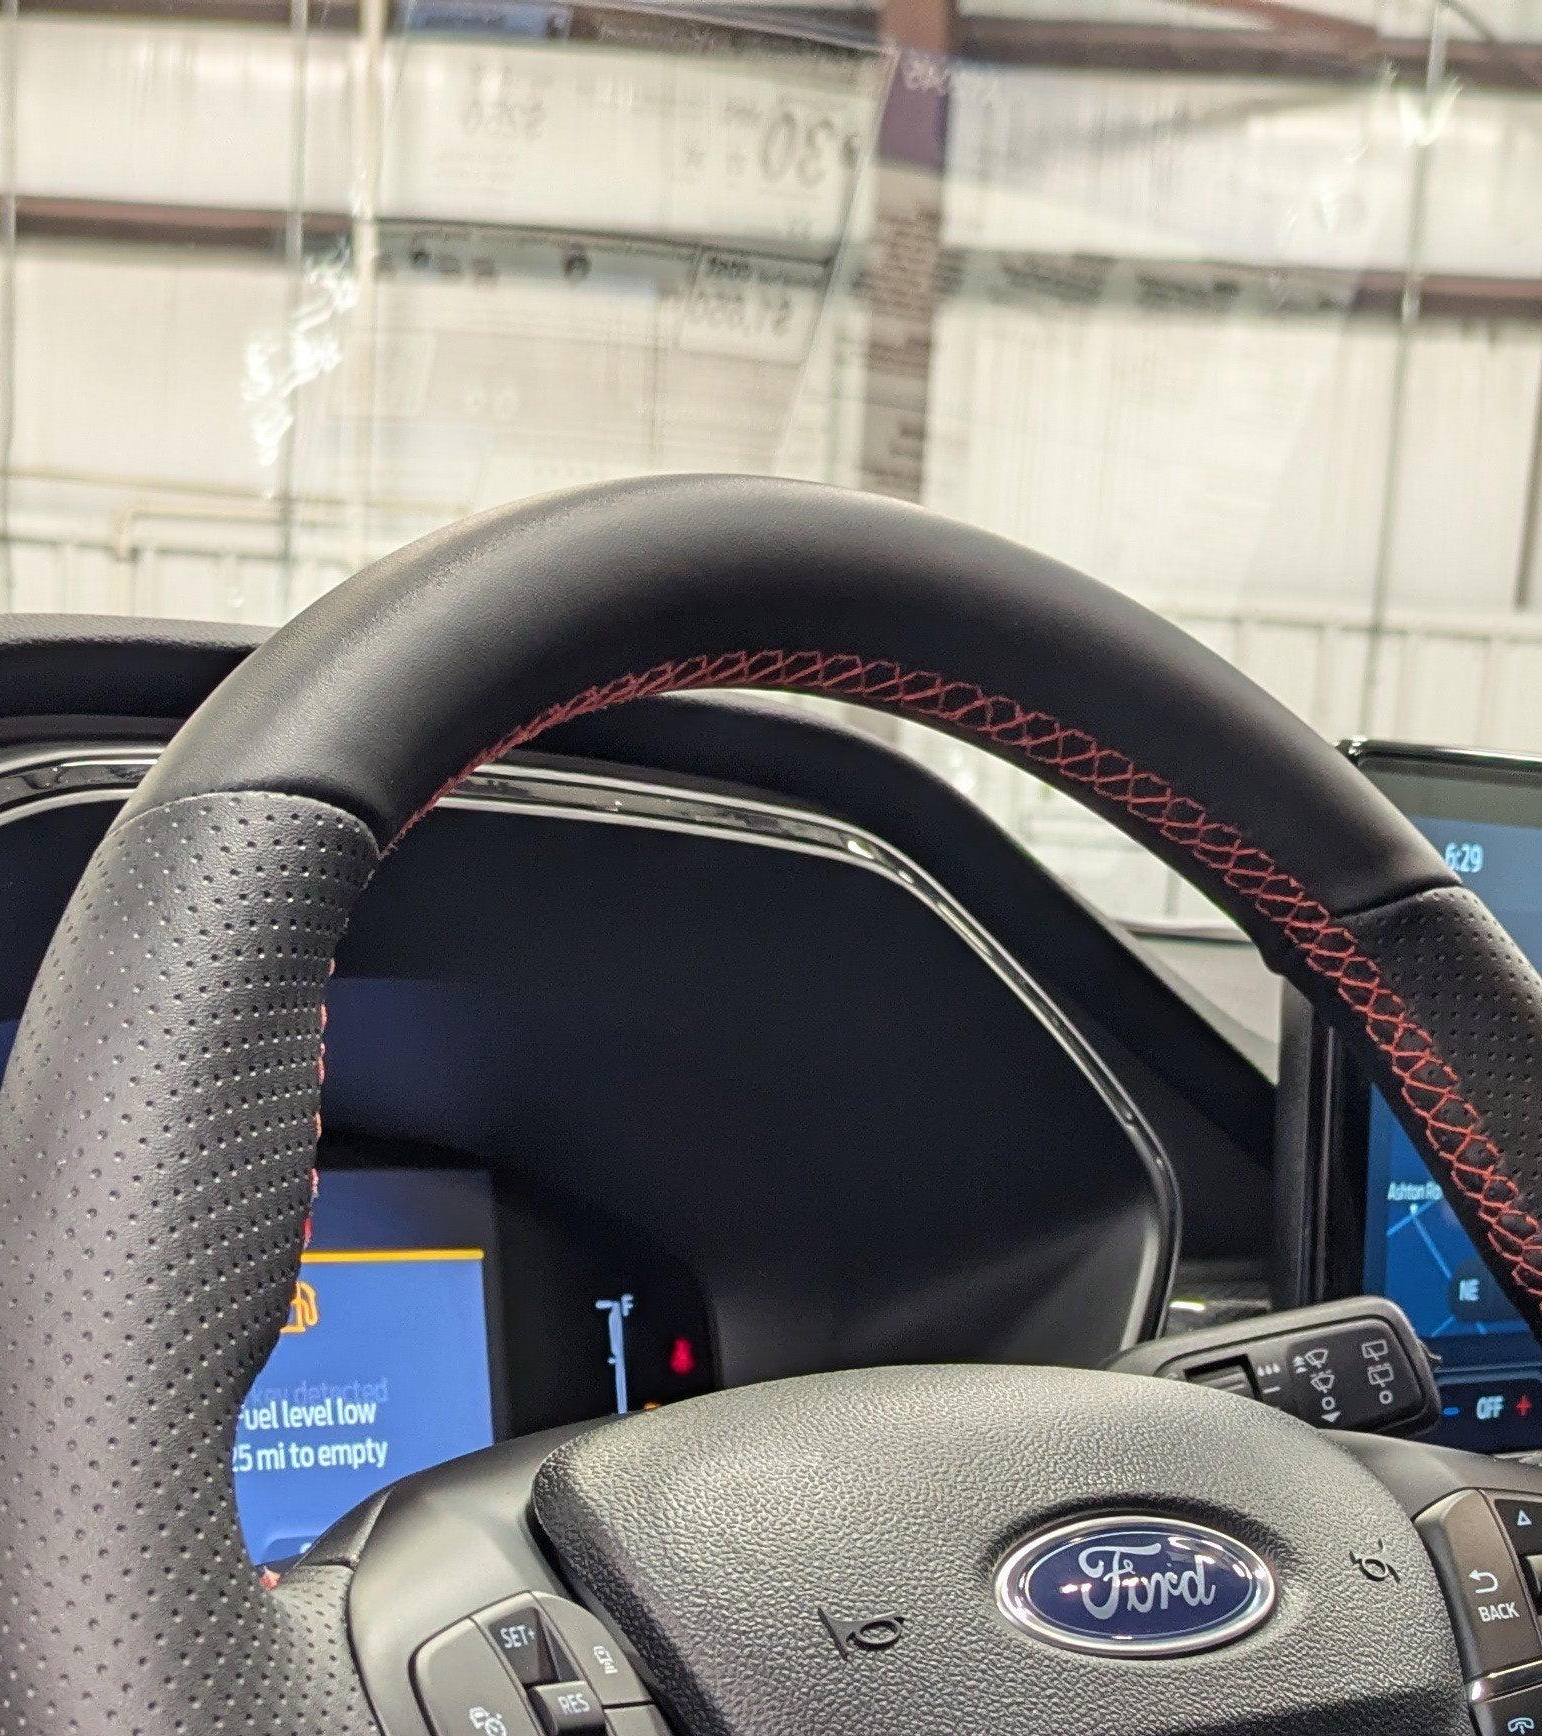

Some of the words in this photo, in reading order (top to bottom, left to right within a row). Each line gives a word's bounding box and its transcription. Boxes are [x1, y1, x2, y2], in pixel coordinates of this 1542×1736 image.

[1445, 842, 1484, 872] 6:29
[1387, 1181, 1424, 1200] Ashton
[1459, 1279, 1480, 1301] NE
[621, 1293, 634, 1316] F
[238, 1401, 277, 1431] uel
[282, 1398, 334, 1428] level
[337, 1398, 377, 1425] low
[1476, 1395, 1504, 1420] OFF
[256, 1441, 286, 1471] mi
[289, 1442, 315, 1468] to
[318, 1438, 388, 1469] empty
[1077, 1543, 1216, 1619] Ford
[1477, 1602, 1520, 1623] BACK
[558, 1693, 591, 1716] RES
